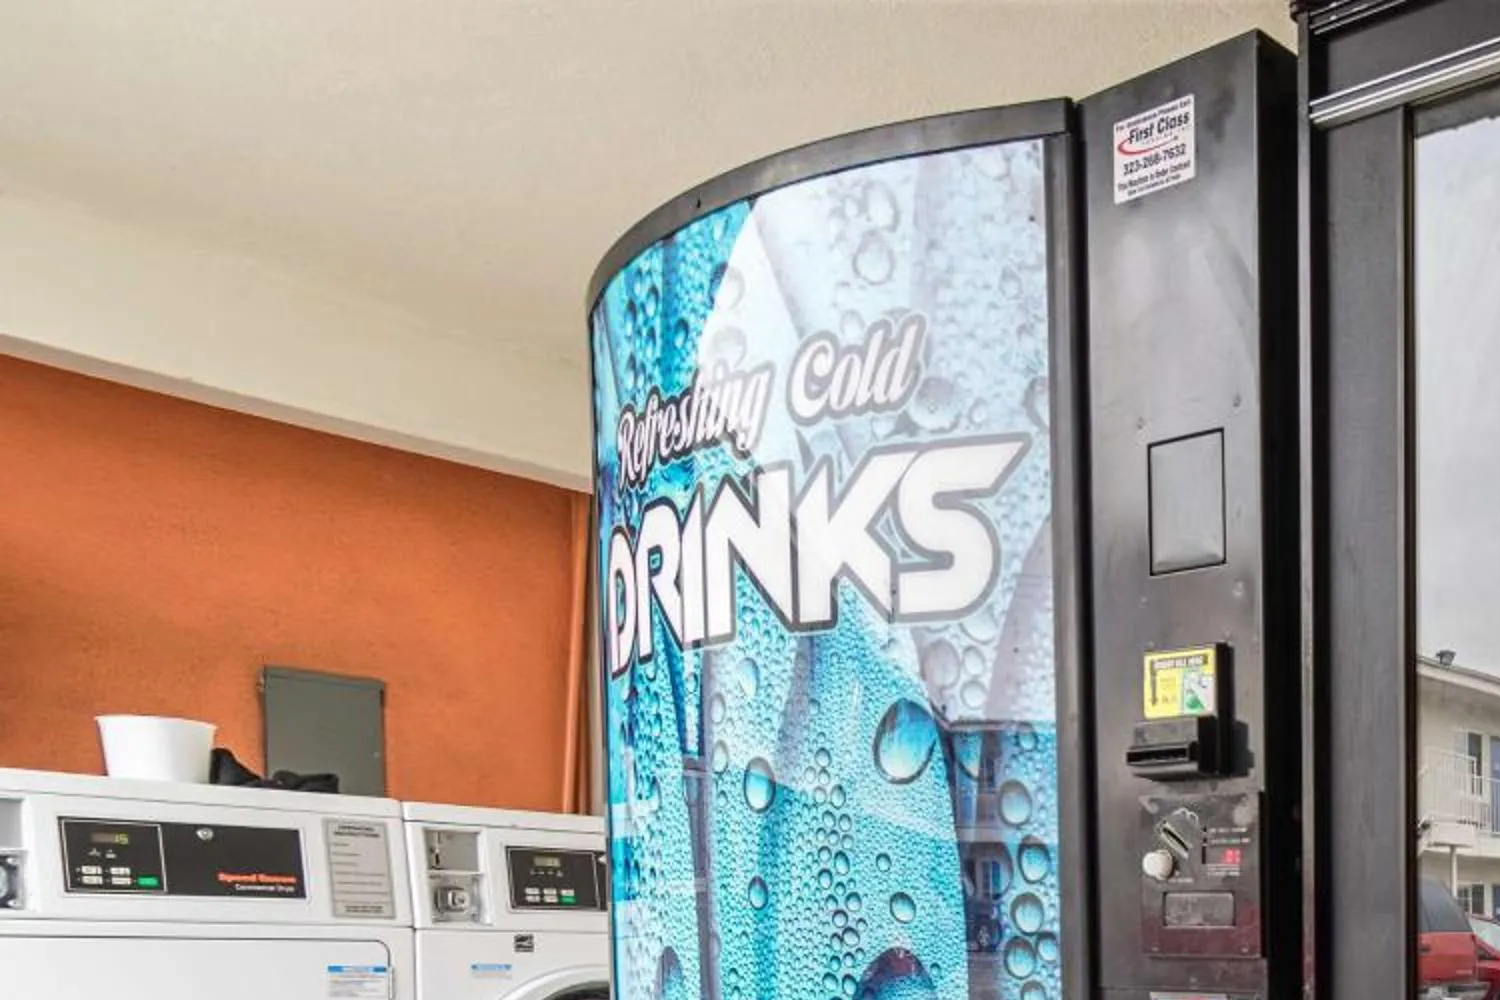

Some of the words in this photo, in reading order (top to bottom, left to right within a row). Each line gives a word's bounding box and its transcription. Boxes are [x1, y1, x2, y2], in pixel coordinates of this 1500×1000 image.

[1129, 123, 1154, 145] First
[1157, 111, 1189, 134] Class
[617, 360, 774, 495] Refreshing
[787, 310, 928, 424] Cold
[604, 433, 1032, 679] DRINKS
